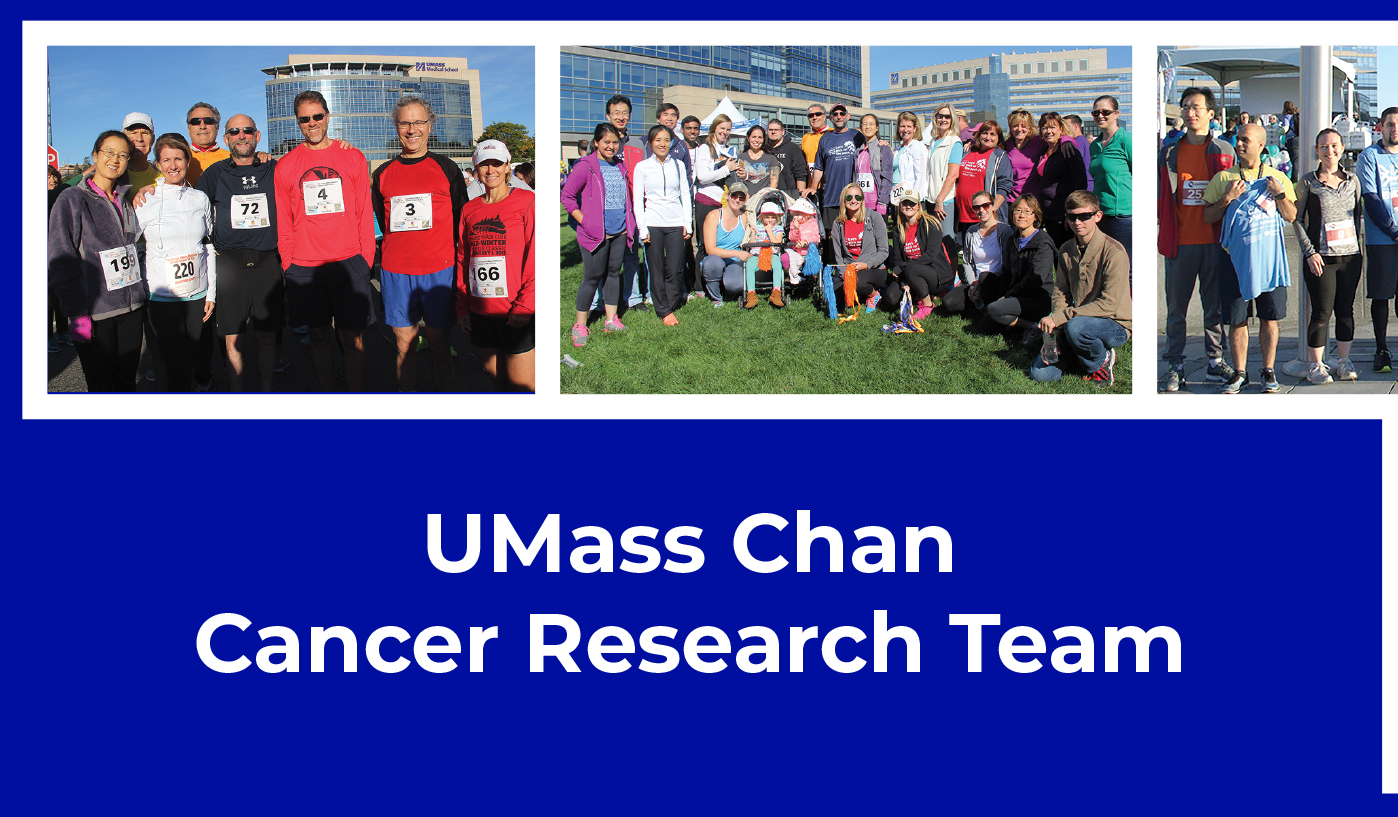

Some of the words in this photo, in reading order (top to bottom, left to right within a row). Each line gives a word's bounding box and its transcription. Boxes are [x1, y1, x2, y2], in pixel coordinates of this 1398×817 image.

[318, 188, 328, 200] 4
[240, 203, 259, 215] 72
[406, 203, 416, 216] 3
[110, 254, 136, 272] 199
[173, 261, 194, 280] 220
